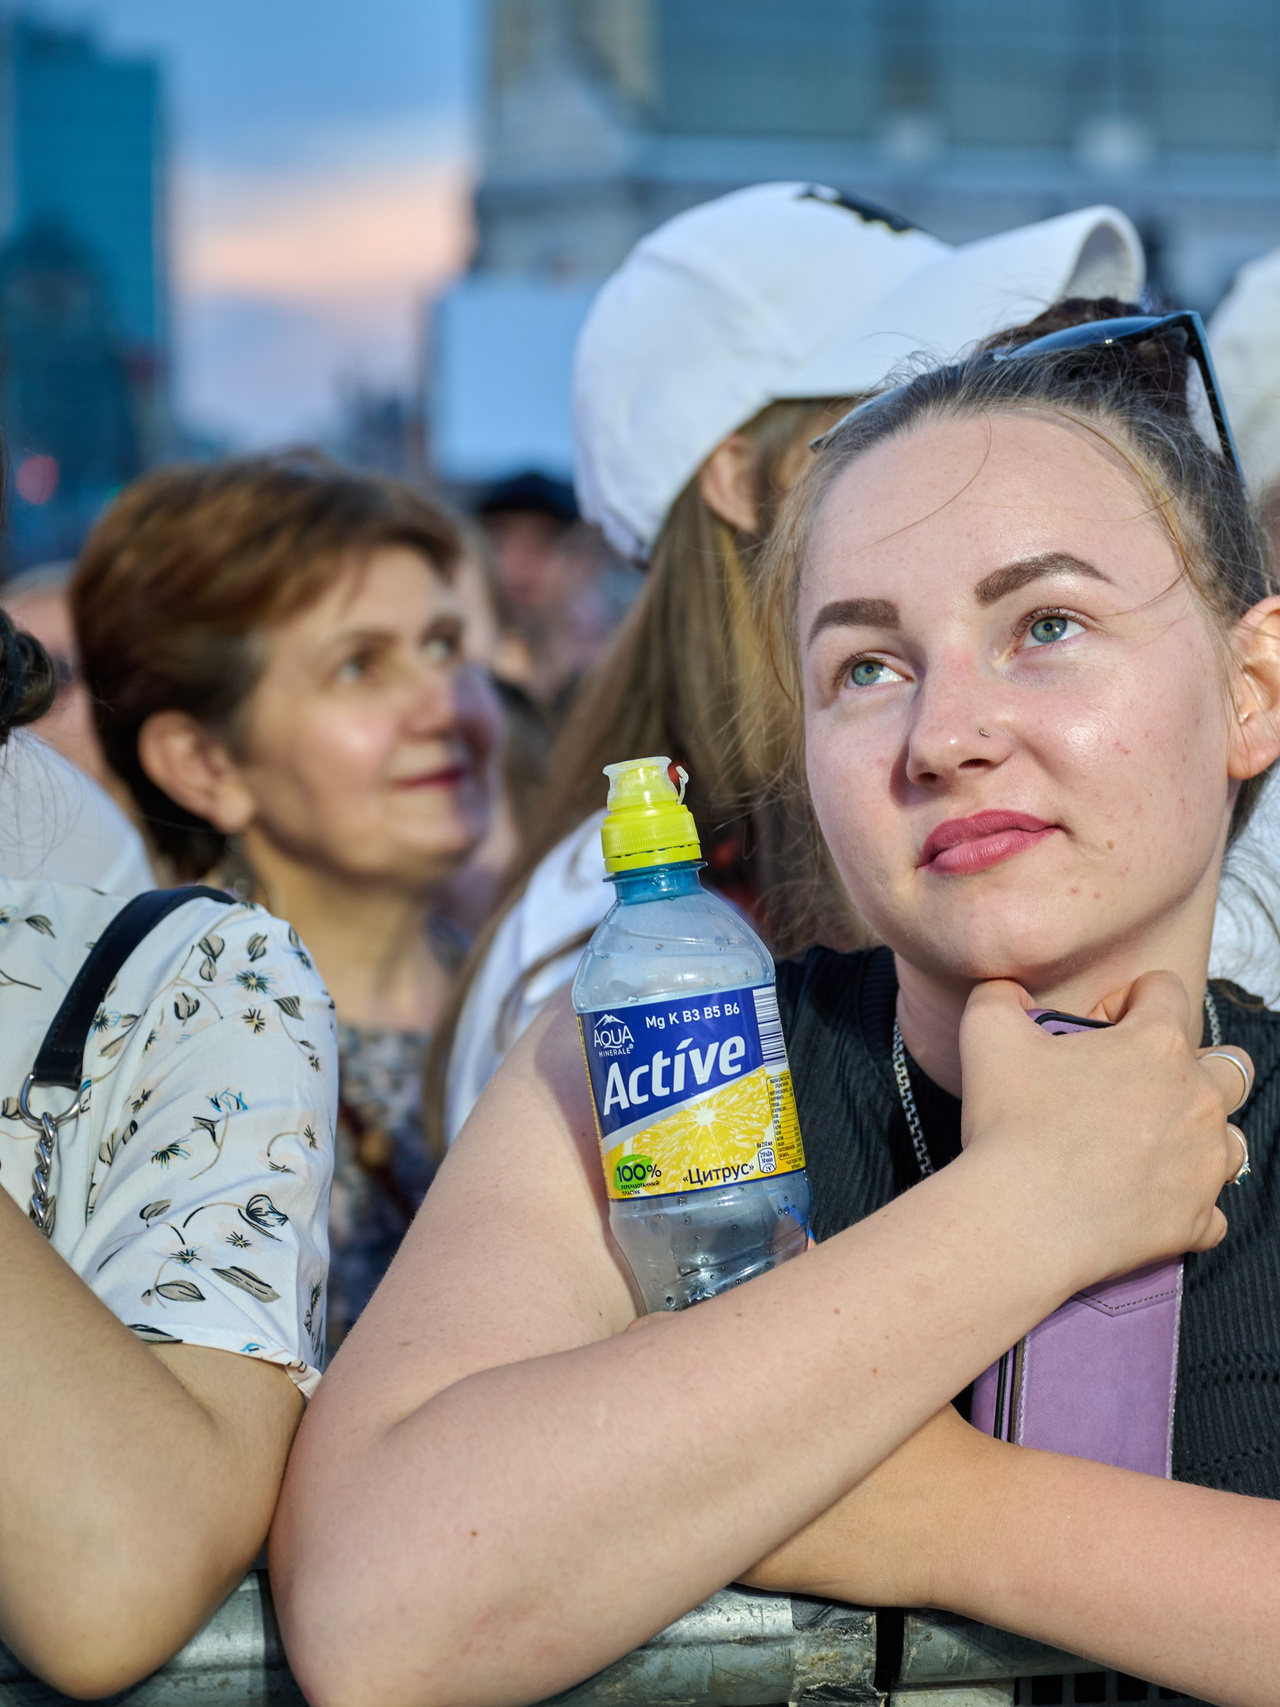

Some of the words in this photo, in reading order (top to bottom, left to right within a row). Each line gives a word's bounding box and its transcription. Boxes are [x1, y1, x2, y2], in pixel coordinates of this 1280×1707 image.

[645, 1015, 666, 1029] Mg
[668, 1012, 680, 1025] K
[682, 1009, 701, 1023] B3
[703, 1005, 721, 1019] B5
[724, 1002, 740, 1016] B6
[593, 1025, 635, 1049] AQUA
[598, 1047, 631, 1058] MINERALE
[616, 1163, 662, 1183] 100%
